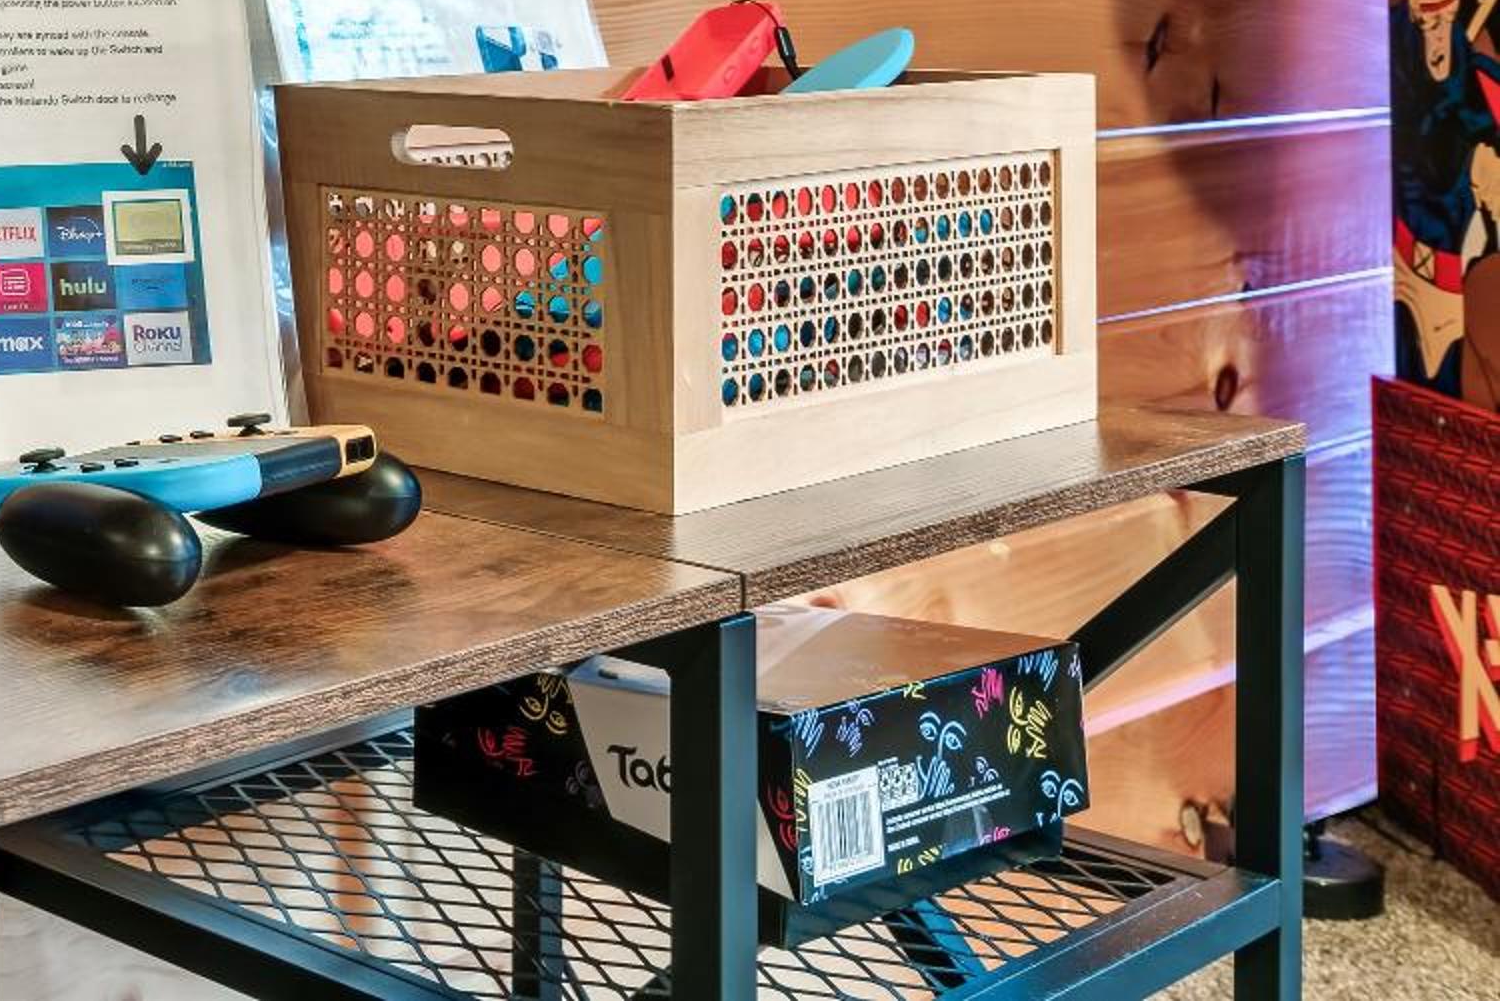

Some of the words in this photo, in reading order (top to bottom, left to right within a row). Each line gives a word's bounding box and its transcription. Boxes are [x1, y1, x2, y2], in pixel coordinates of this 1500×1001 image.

[56, 217, 104, 245] Disney+
[60, 278, 107, 297] hulu
[607, 745, 670, 795] Tab
